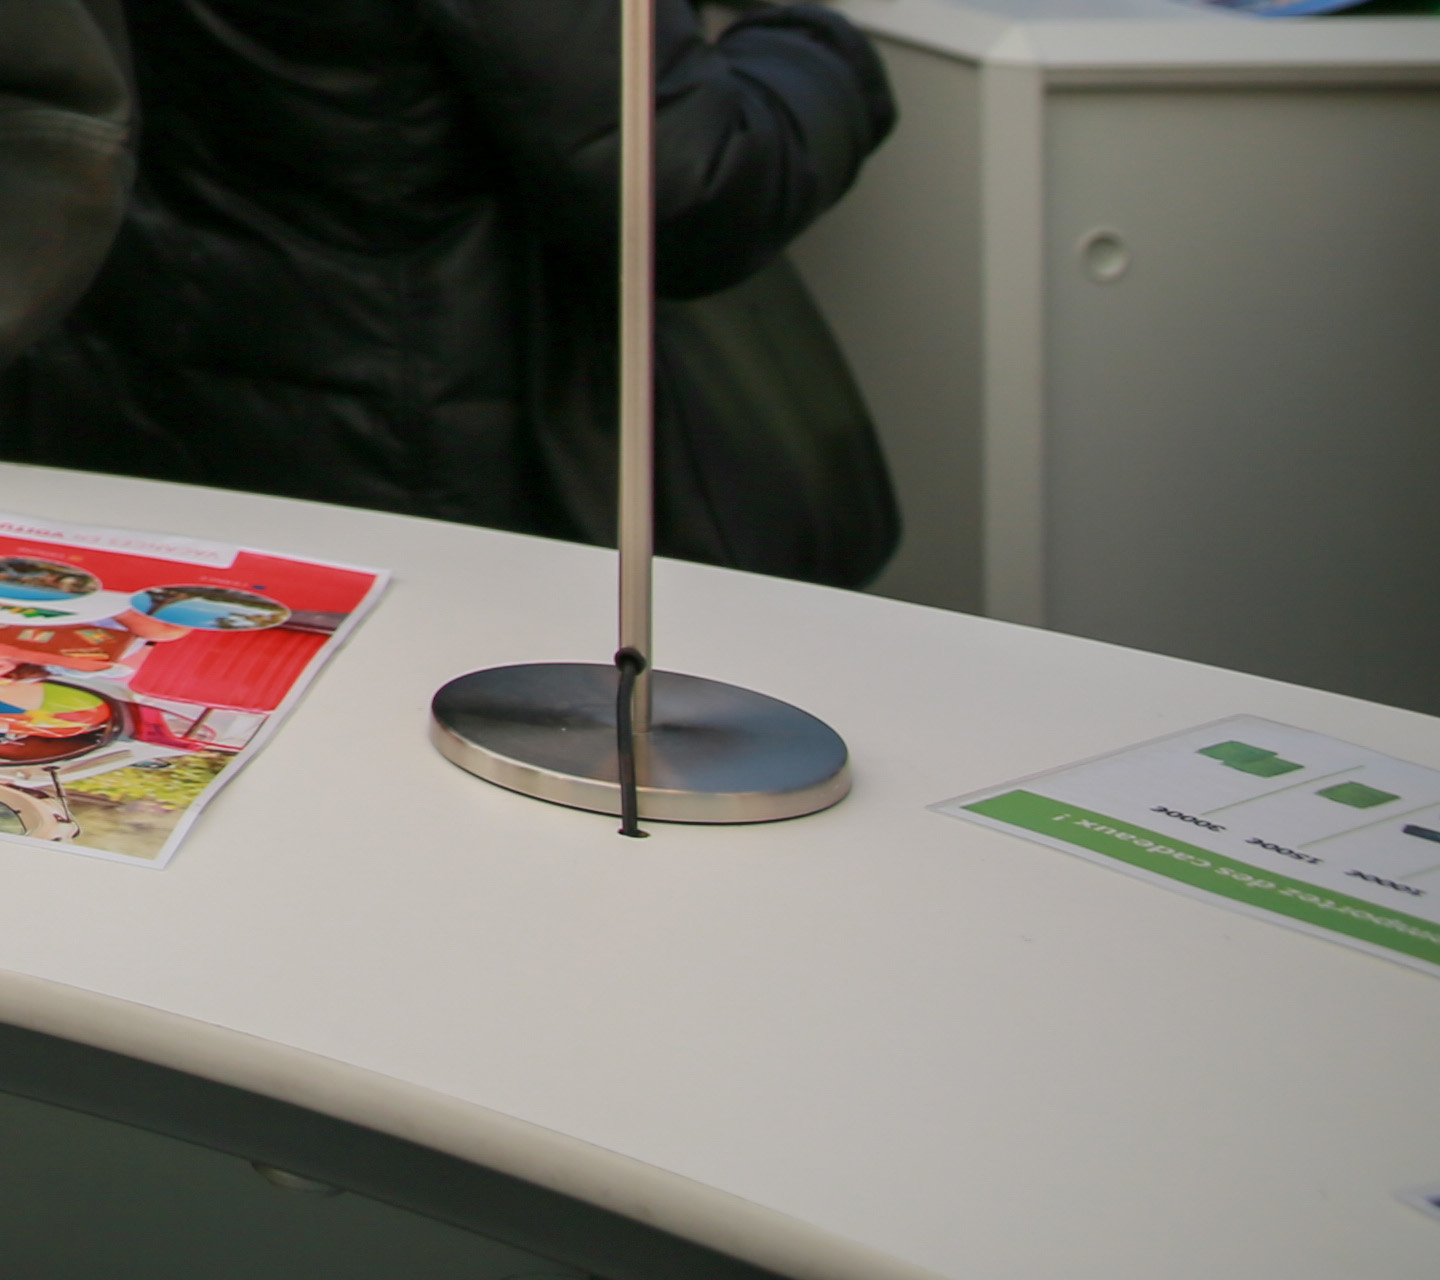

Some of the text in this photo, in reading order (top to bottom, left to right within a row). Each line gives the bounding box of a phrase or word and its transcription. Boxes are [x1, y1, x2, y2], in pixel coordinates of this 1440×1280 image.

[1149, 805, 1227, 833] 3000€
[1073, 817, 1213, 869] cadeaux
[1244, 837, 1325, 865] 1500€
[1214, 866, 1277, 890] des
